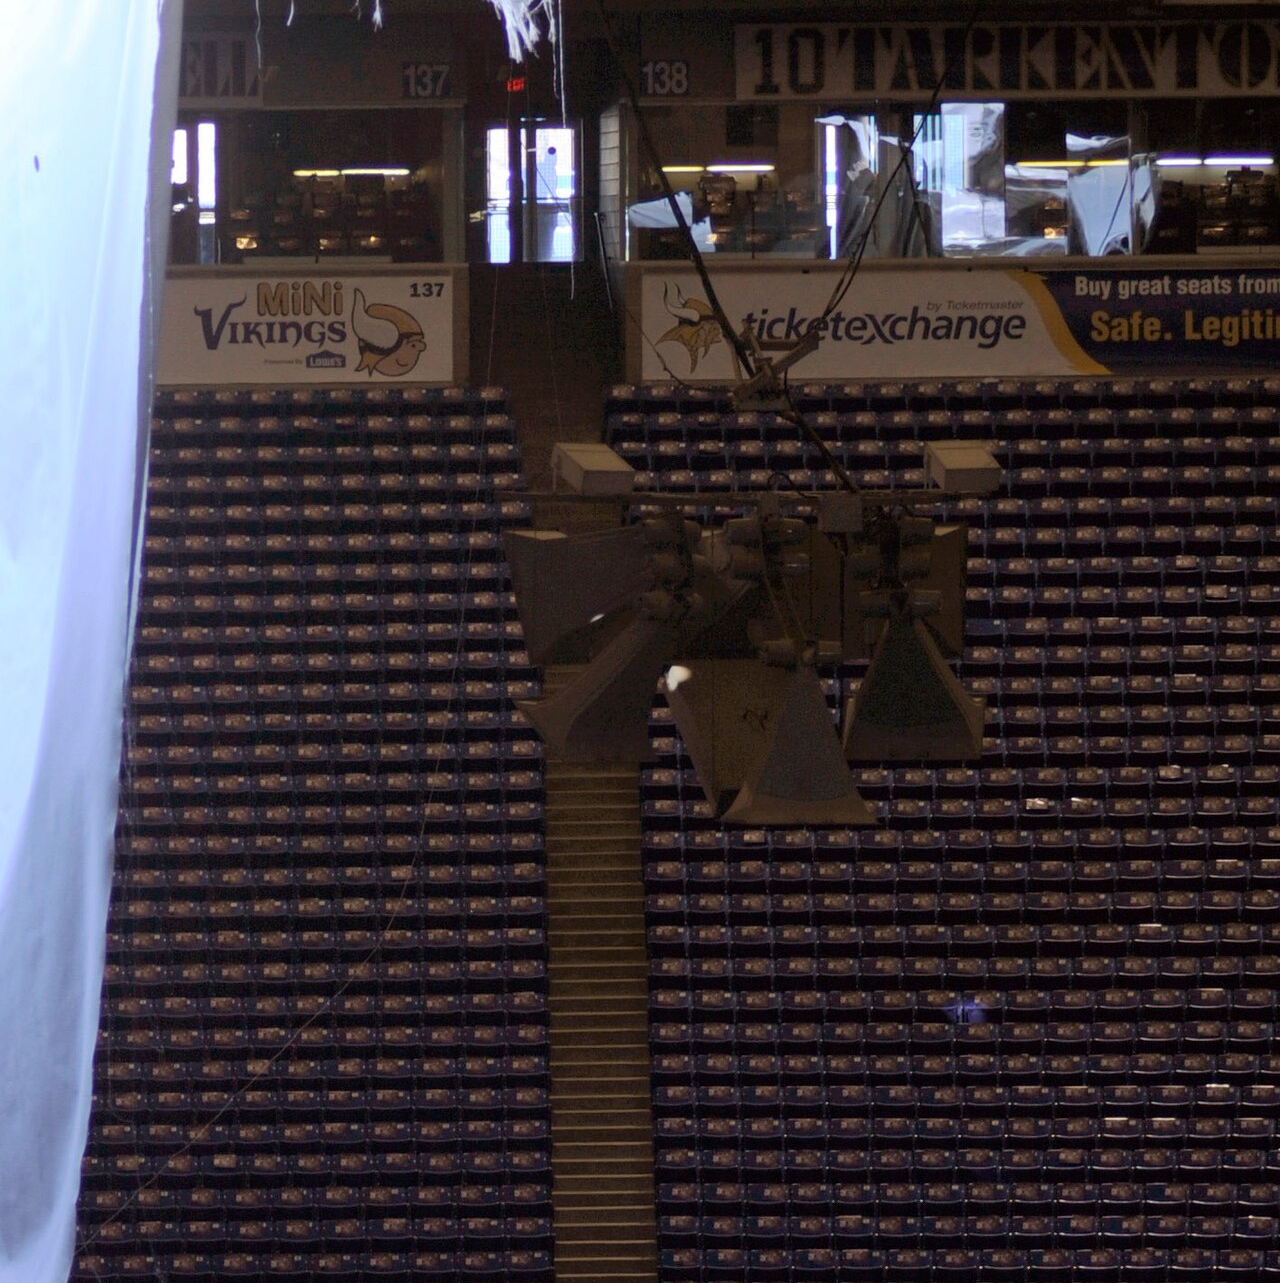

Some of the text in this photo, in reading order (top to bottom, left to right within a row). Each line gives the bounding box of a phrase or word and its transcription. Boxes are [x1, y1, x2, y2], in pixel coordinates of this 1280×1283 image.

[753, 21, 1280, 95] 10 TARKENTO
[405, 64, 451, 97] 137
[642, 61, 688, 96] 138
[409, 282, 445, 298] 137
[1074, 274, 1113, 300] Buy
[1118, 275, 1171, 300] great
[1177, 274, 1232, 295] seats
[194, 292, 348, 351] VIKINGS
[926, 300, 1025, 312] by Ticketmaster
[1090, 307, 1280, 349] Safe. Legiti
